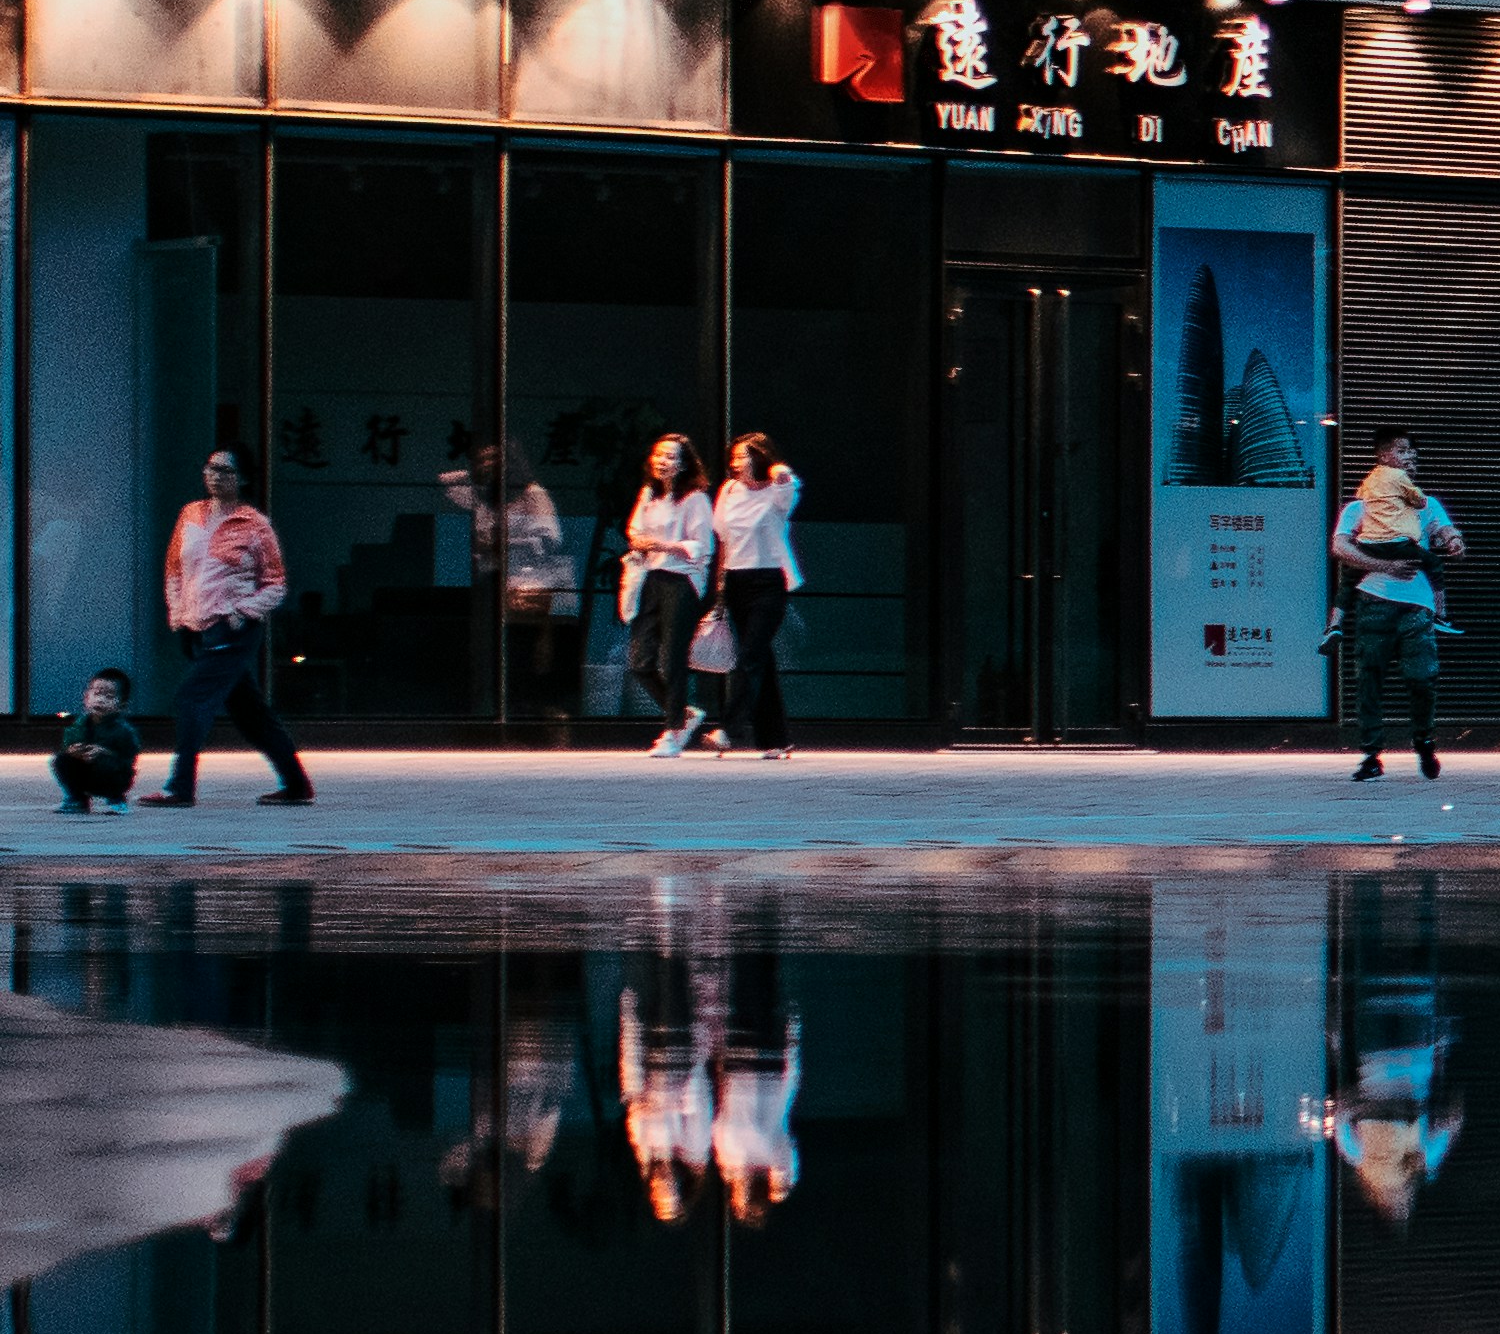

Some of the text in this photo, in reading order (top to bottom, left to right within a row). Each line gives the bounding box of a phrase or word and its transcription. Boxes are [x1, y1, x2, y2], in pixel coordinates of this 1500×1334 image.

[935, 103, 1273, 153] YUAN XING DI CHAN
